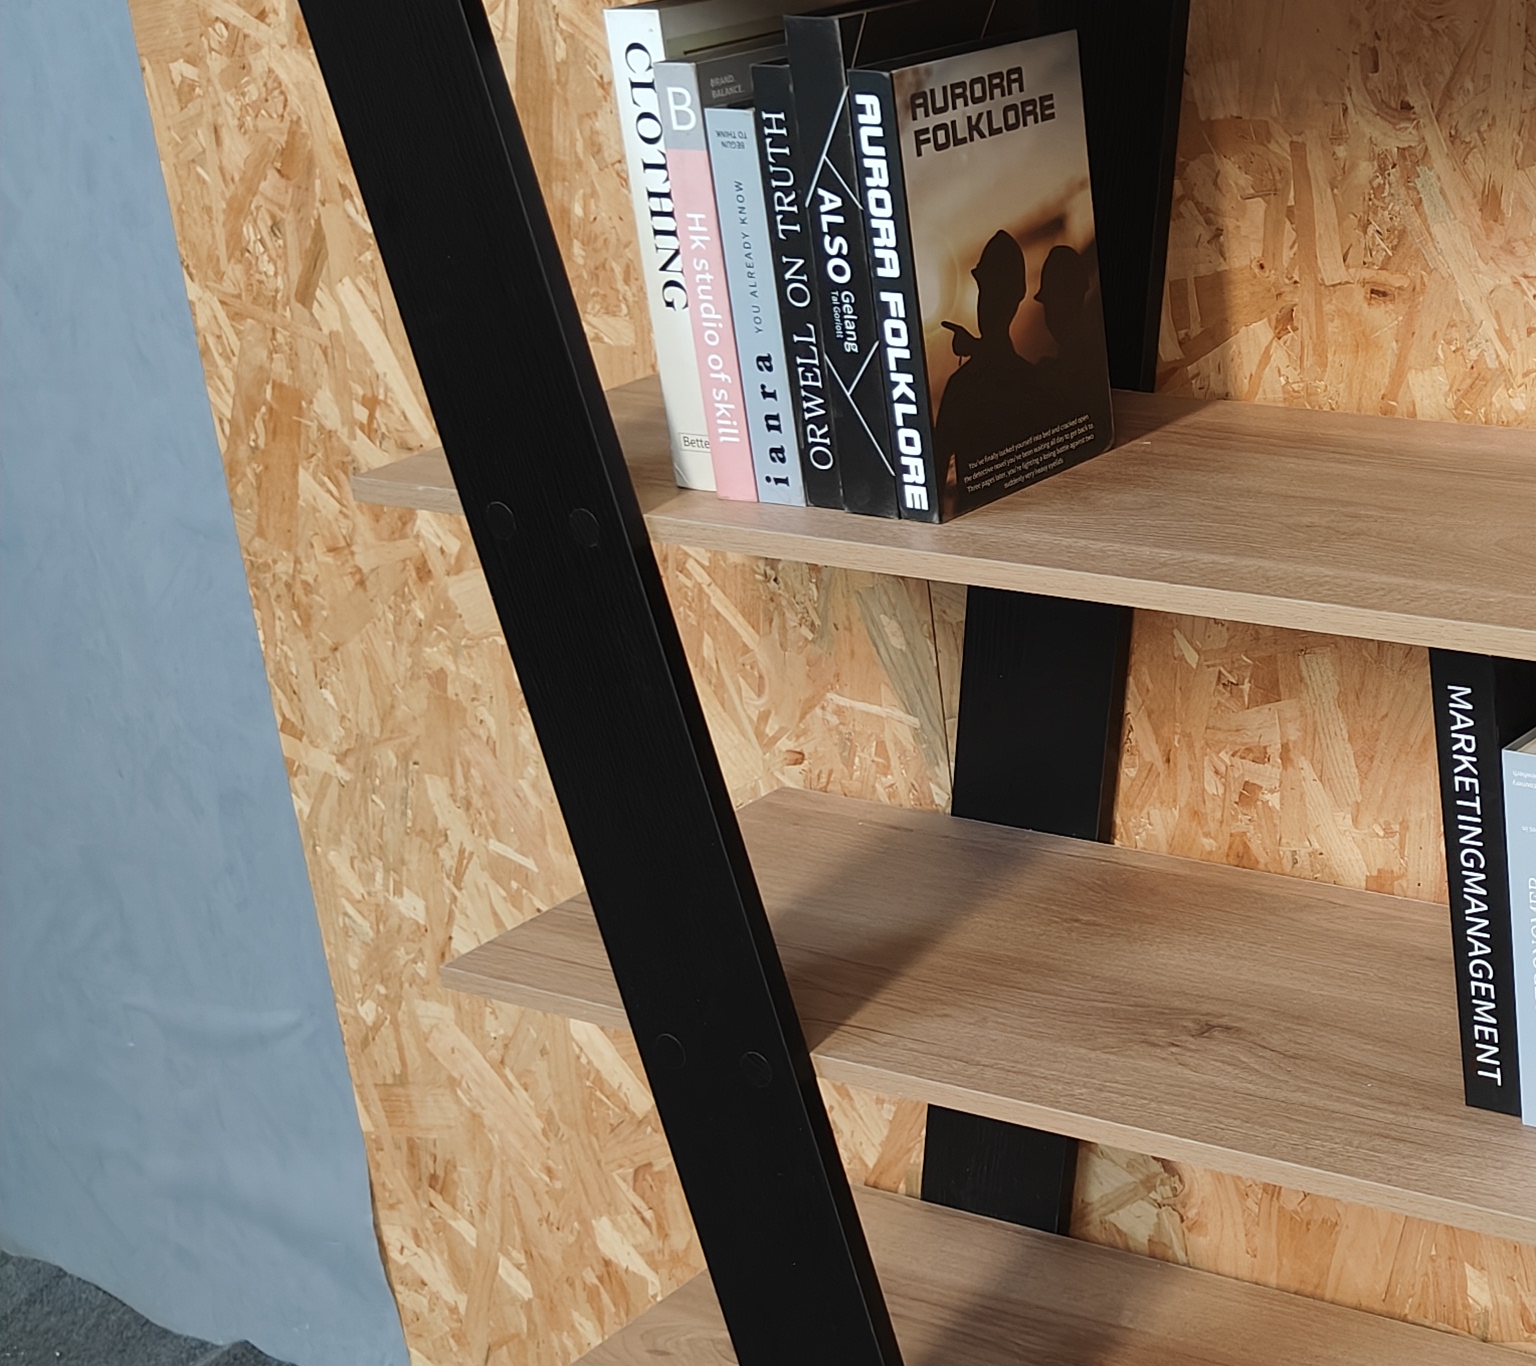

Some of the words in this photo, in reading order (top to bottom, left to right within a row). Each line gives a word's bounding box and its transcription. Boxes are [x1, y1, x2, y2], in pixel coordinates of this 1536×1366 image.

[666, 86, 697, 132] B
[909, 66, 1024, 121] AURORA
[913, 93, 1056, 158] FOLKLORE
[625, 42, 689, 311] CLOTHING
[734, 180, 747, 225] KNOW
[761, 110, 801, 240] TRUTH
[740, 232, 758, 298] ALREADY
[816, 187, 852, 285] ALSO
[692, 257, 724, 347] studio
[782, 254, 811, 309] ON
[855, 94, 901, 278] AURORA
[880, 291, 930, 511] FOLKLORE
[754, 305, 764, 334] YOU
[841, 290, 859, 354] Gelang
[707, 353, 732, 386] of
[792, 322, 835, 470] ORWELL
[712, 388, 741, 443] skill
[1447, 684, 1502, 1087] MARKETINGMANAGEMENT
